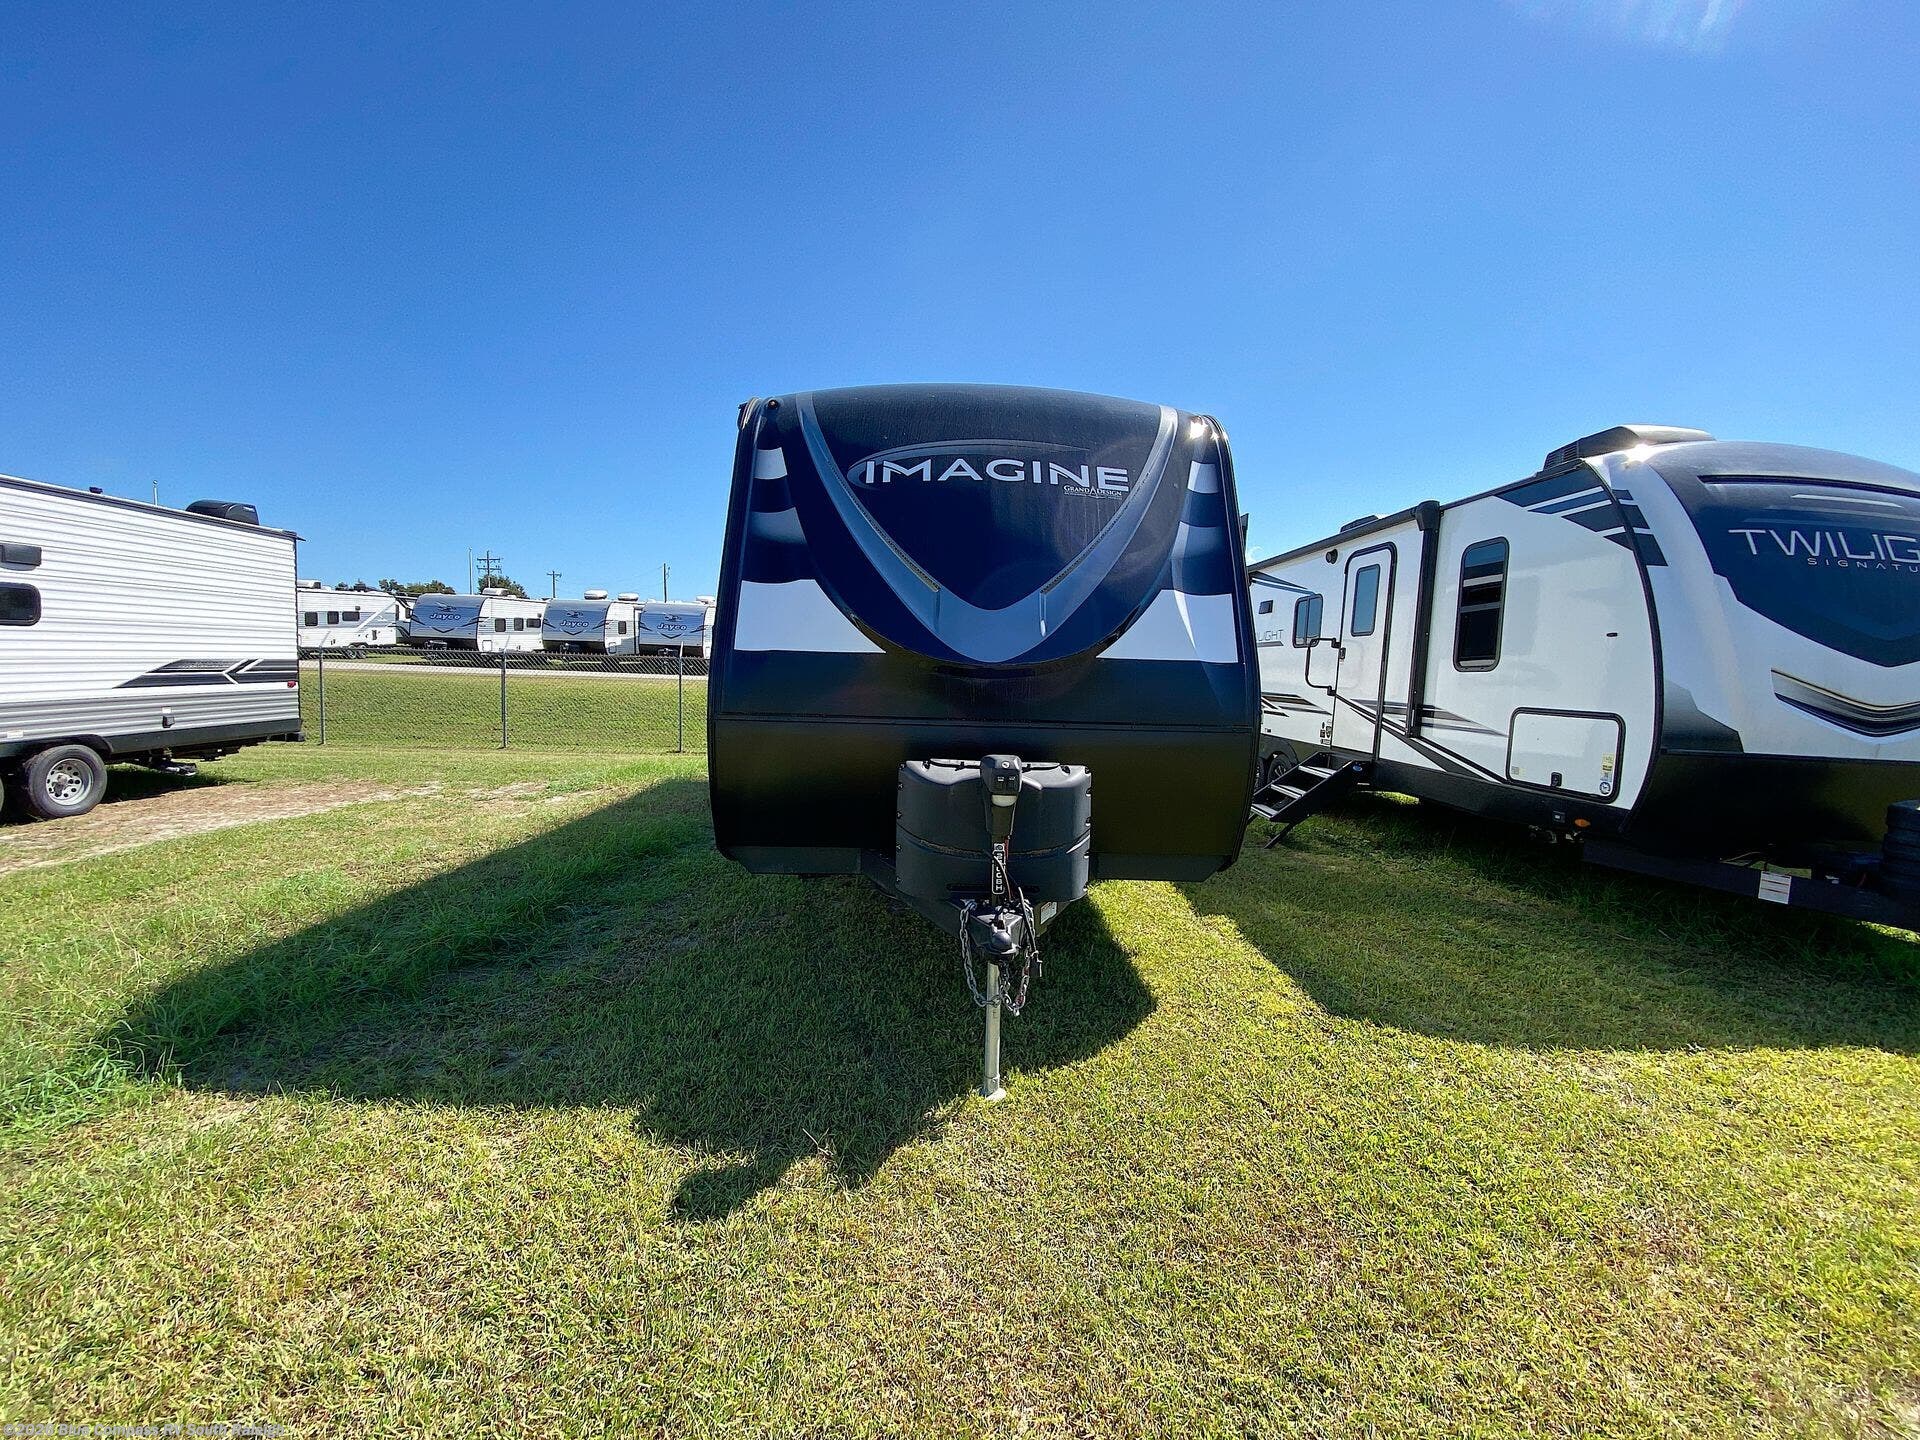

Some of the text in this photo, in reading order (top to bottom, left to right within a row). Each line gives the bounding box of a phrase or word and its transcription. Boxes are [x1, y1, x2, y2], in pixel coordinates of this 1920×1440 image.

[865, 457, 1129, 492] IMAGINE
[1728, 529, 1920, 563] TWILIG
[560, 620, 589, 628] Jayco
[657, 622, 687, 631] Jayco
